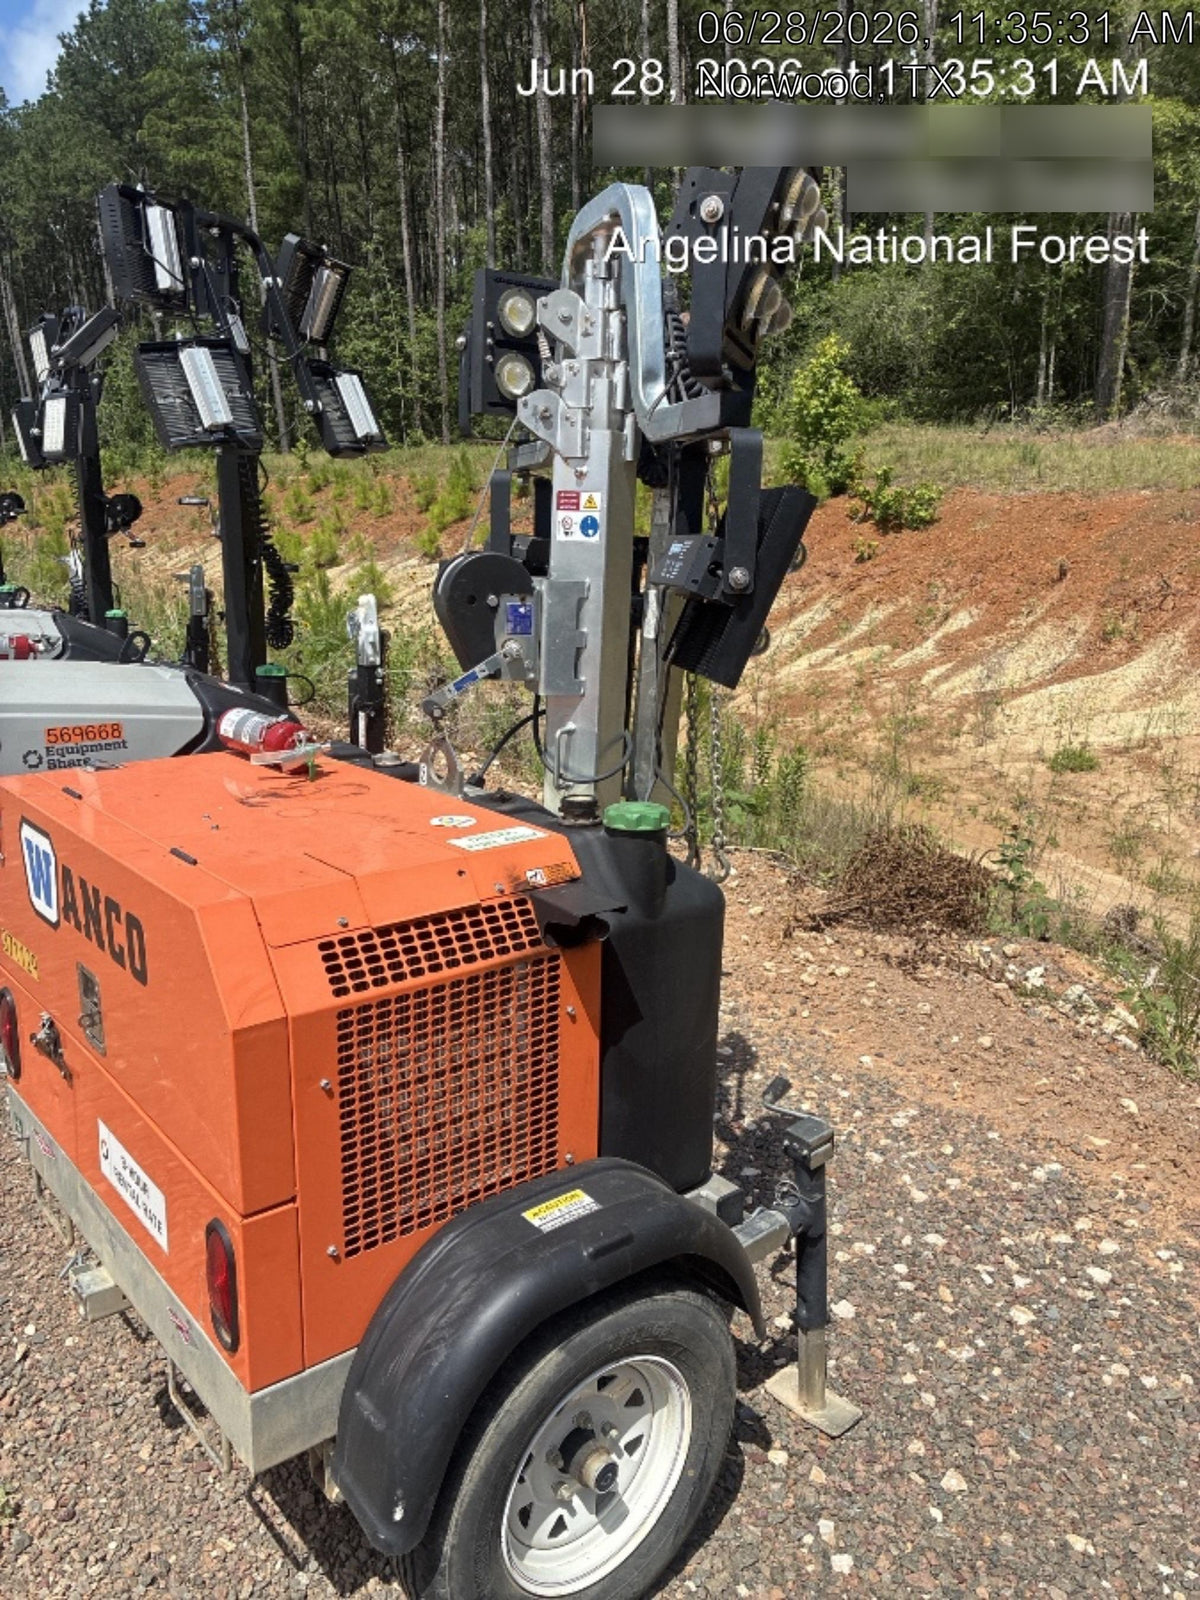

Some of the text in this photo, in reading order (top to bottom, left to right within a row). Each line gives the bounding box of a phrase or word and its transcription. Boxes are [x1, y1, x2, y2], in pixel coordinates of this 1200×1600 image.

[46, 722, 123, 745] 569668
[45, 739, 129, 758] Equipment
[46, 757, 92, 770] Share
[24, 836, 148, 987] WANCO
